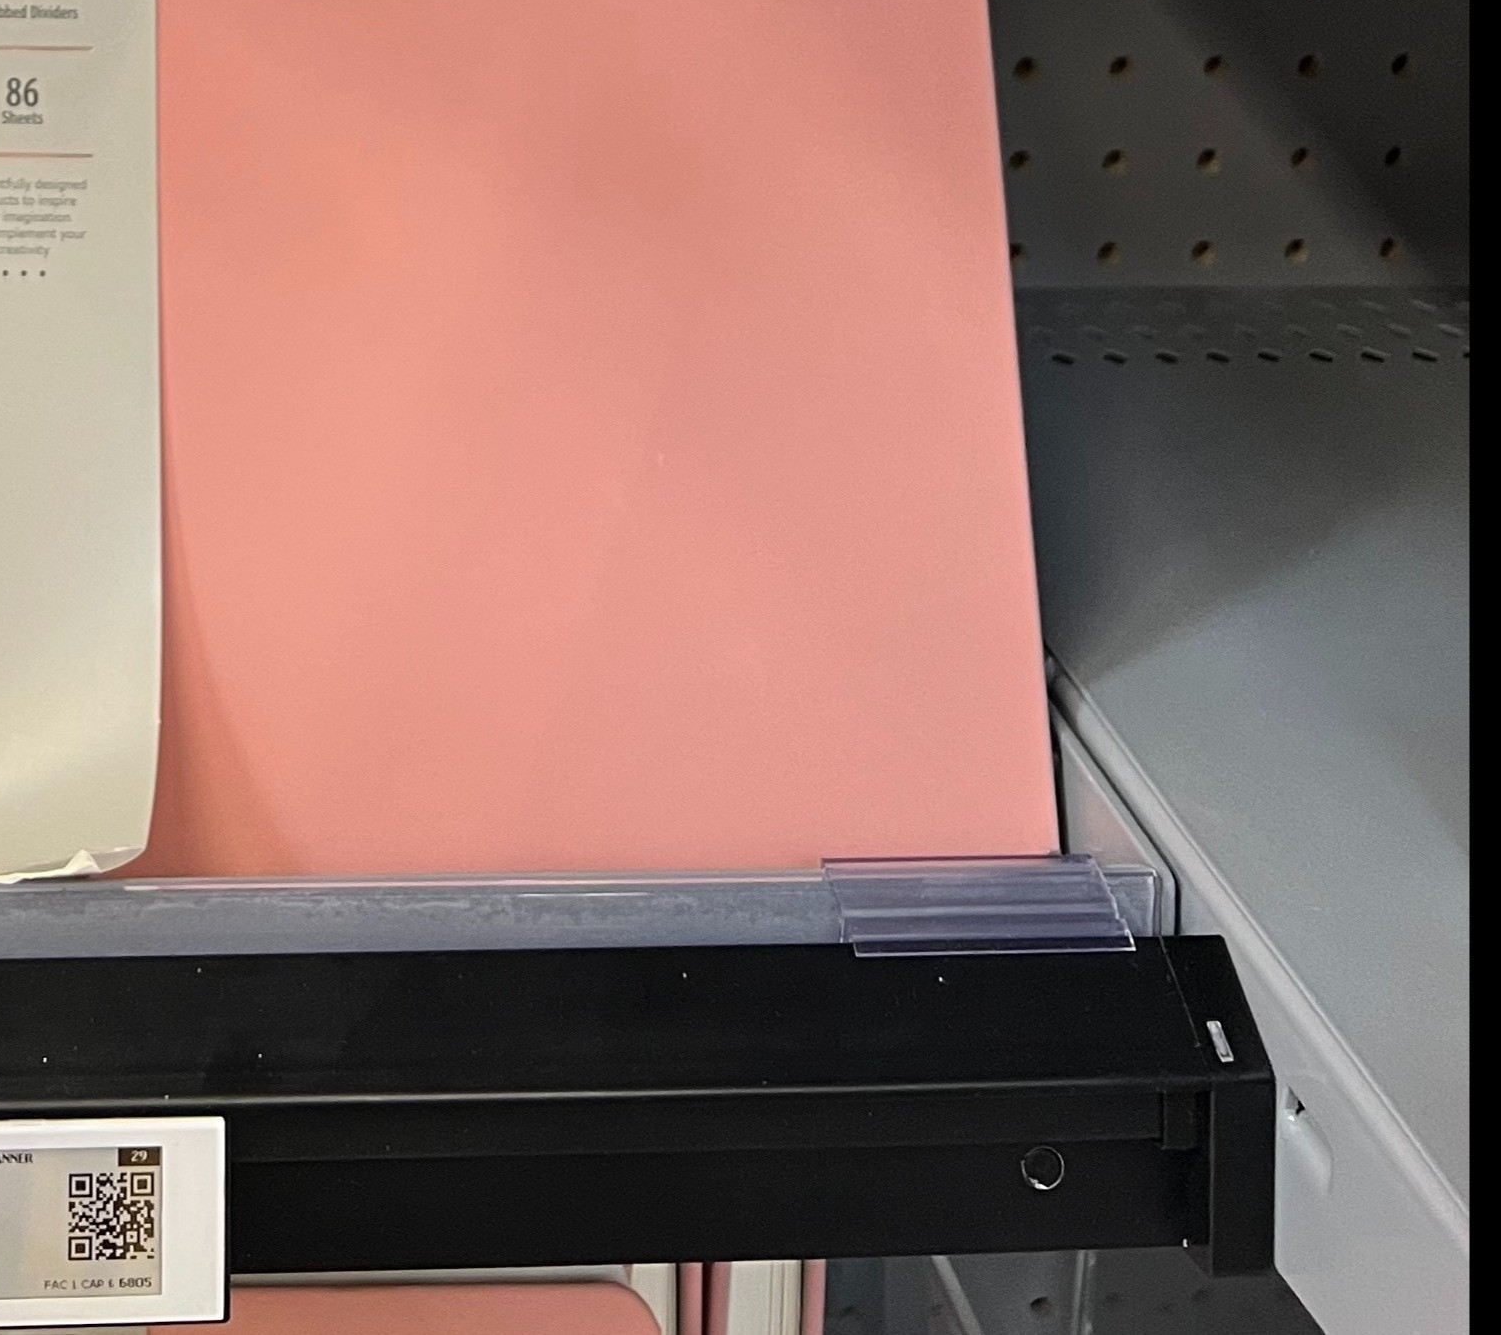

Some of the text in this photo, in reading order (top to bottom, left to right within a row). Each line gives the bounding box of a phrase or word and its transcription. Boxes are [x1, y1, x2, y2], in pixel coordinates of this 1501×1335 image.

[30, 5, 79, 19] Dividers
[6, 77, 39, 107] 86
[1, 110, 44, 124] Sheets
[131, 1150, 148, 1163] 29
[44, 1280, 67, 1291] FAC
[81, 1279, 105, 1290] CAP
[119, 1277, 153, 1289] 6805
